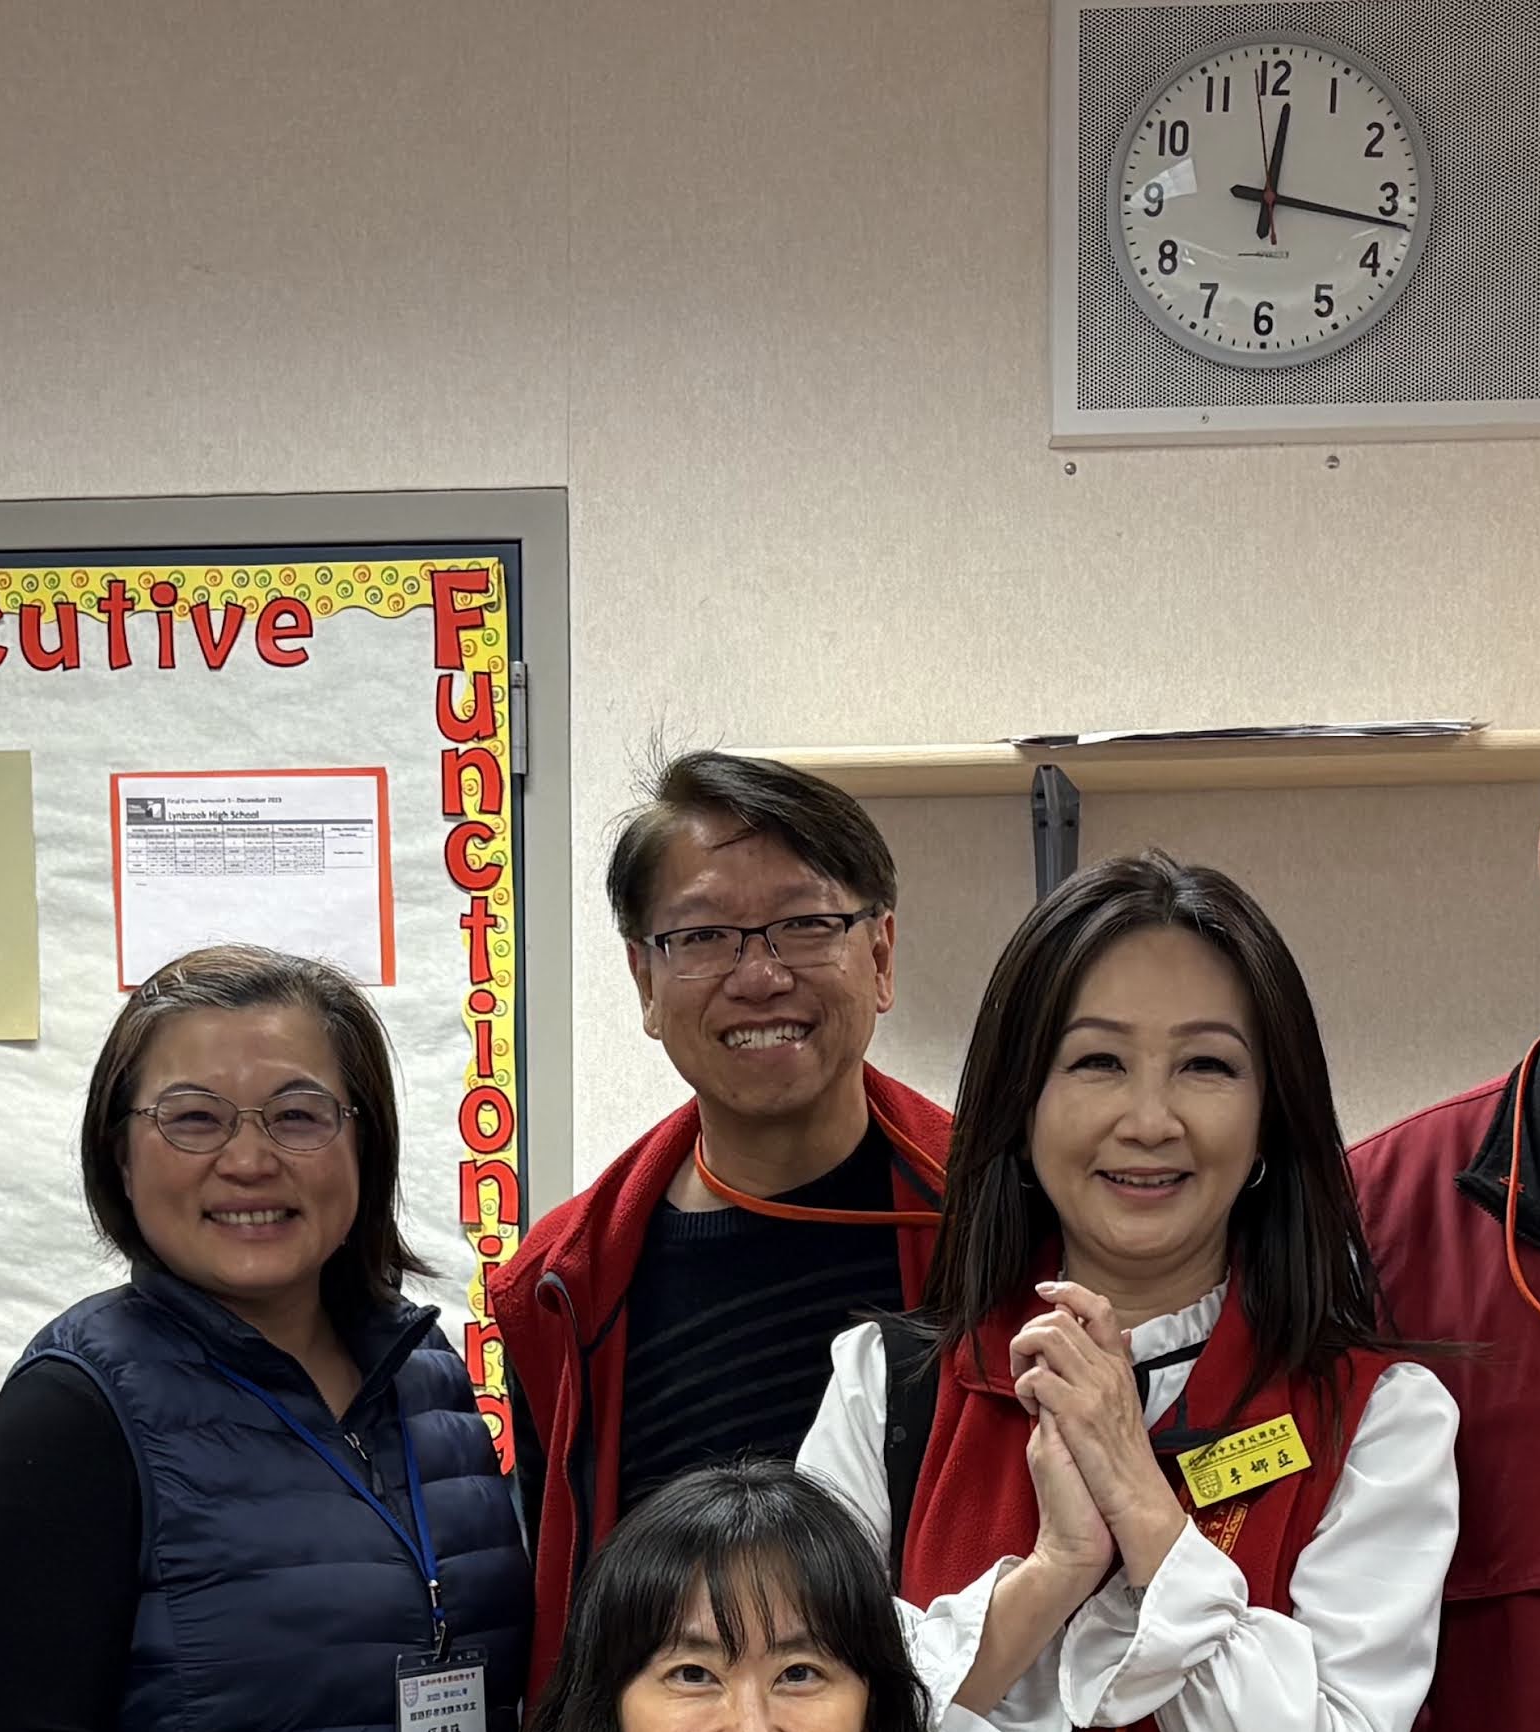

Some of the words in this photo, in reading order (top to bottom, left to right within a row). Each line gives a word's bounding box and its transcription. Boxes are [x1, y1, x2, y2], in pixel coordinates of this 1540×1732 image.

[1205, 77, 1230, 112] 11
[1261, 61, 1291, 96] 12
[1328, 78, 1338, 113] 1
[1158, 121, 1190, 157] 10
[1365, 123, 1384, 158] 2
[1143, 182, 1164, 216] 9
[1379, 184, 1399, 216] 3
[1158, 241, 1178, 276] 8
[1359, 244, 1381, 277] 4
[1200, 284, 1219, 320] 7
[1314, 285, 1335, 319] 5
[1253, 302, 1274, 338] 6
[230, 810, 260, 820] School
